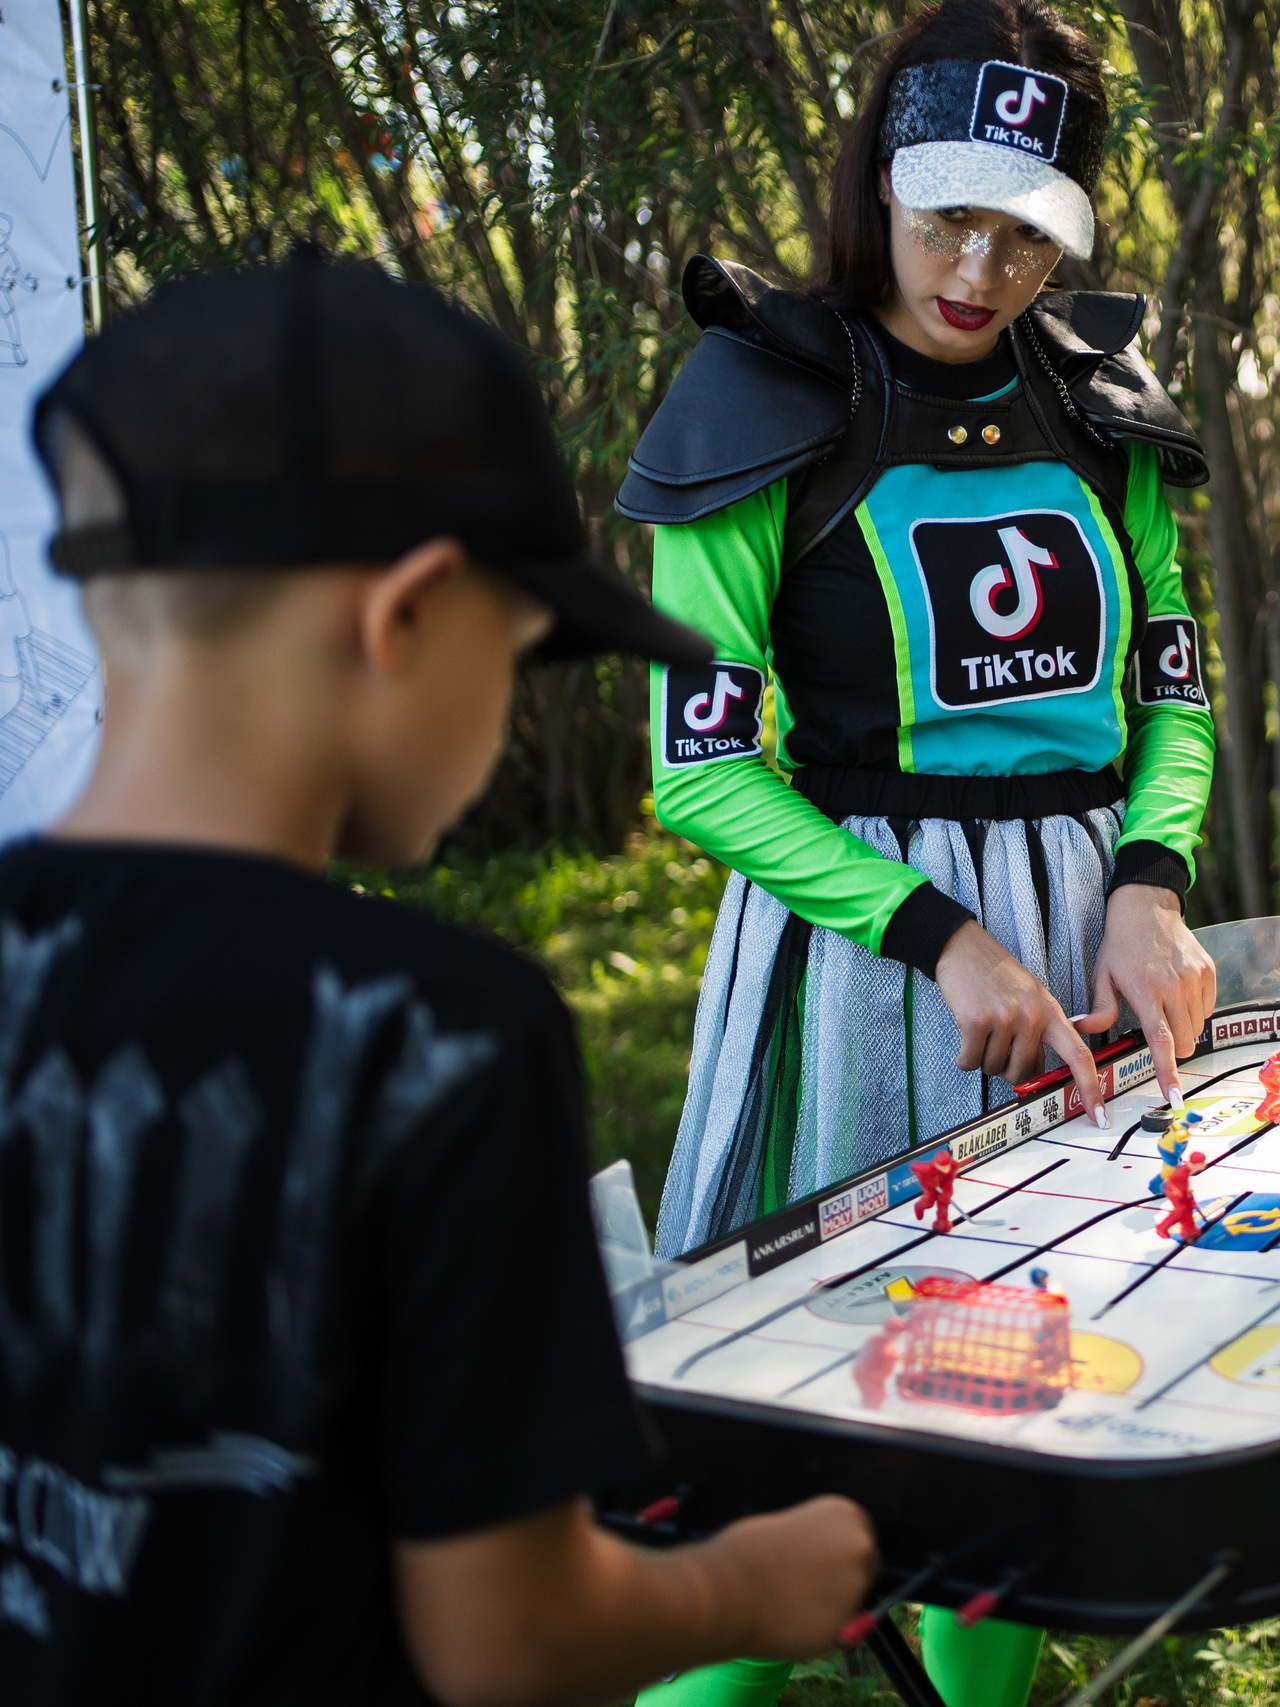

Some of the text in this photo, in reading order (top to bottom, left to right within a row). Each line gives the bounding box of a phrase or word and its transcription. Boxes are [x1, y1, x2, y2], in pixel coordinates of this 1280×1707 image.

[984, 124, 1044, 154] TikTok
[960, 645, 1078, 691] TikTok
[675, 737, 745, 757] TikTok
[1043, 1095, 1056, 1108] UTE
[1015, 1109, 1028, 1122] UTE
[1049, 1112, 1058, 1122] EN
[957, 1122, 1007, 1160] BLÅKLÄDER
[1021, 1125, 1030, 1136] EN
[857, 1178, 885, 1201] LIQUI
[822, 1194, 852, 1220] LIQUI
[858, 1193, 887, 1218] MOLY
[823, 1209, 853, 1236] MOLY
[752, 1221, 816, 1262] ANKARSRUM
